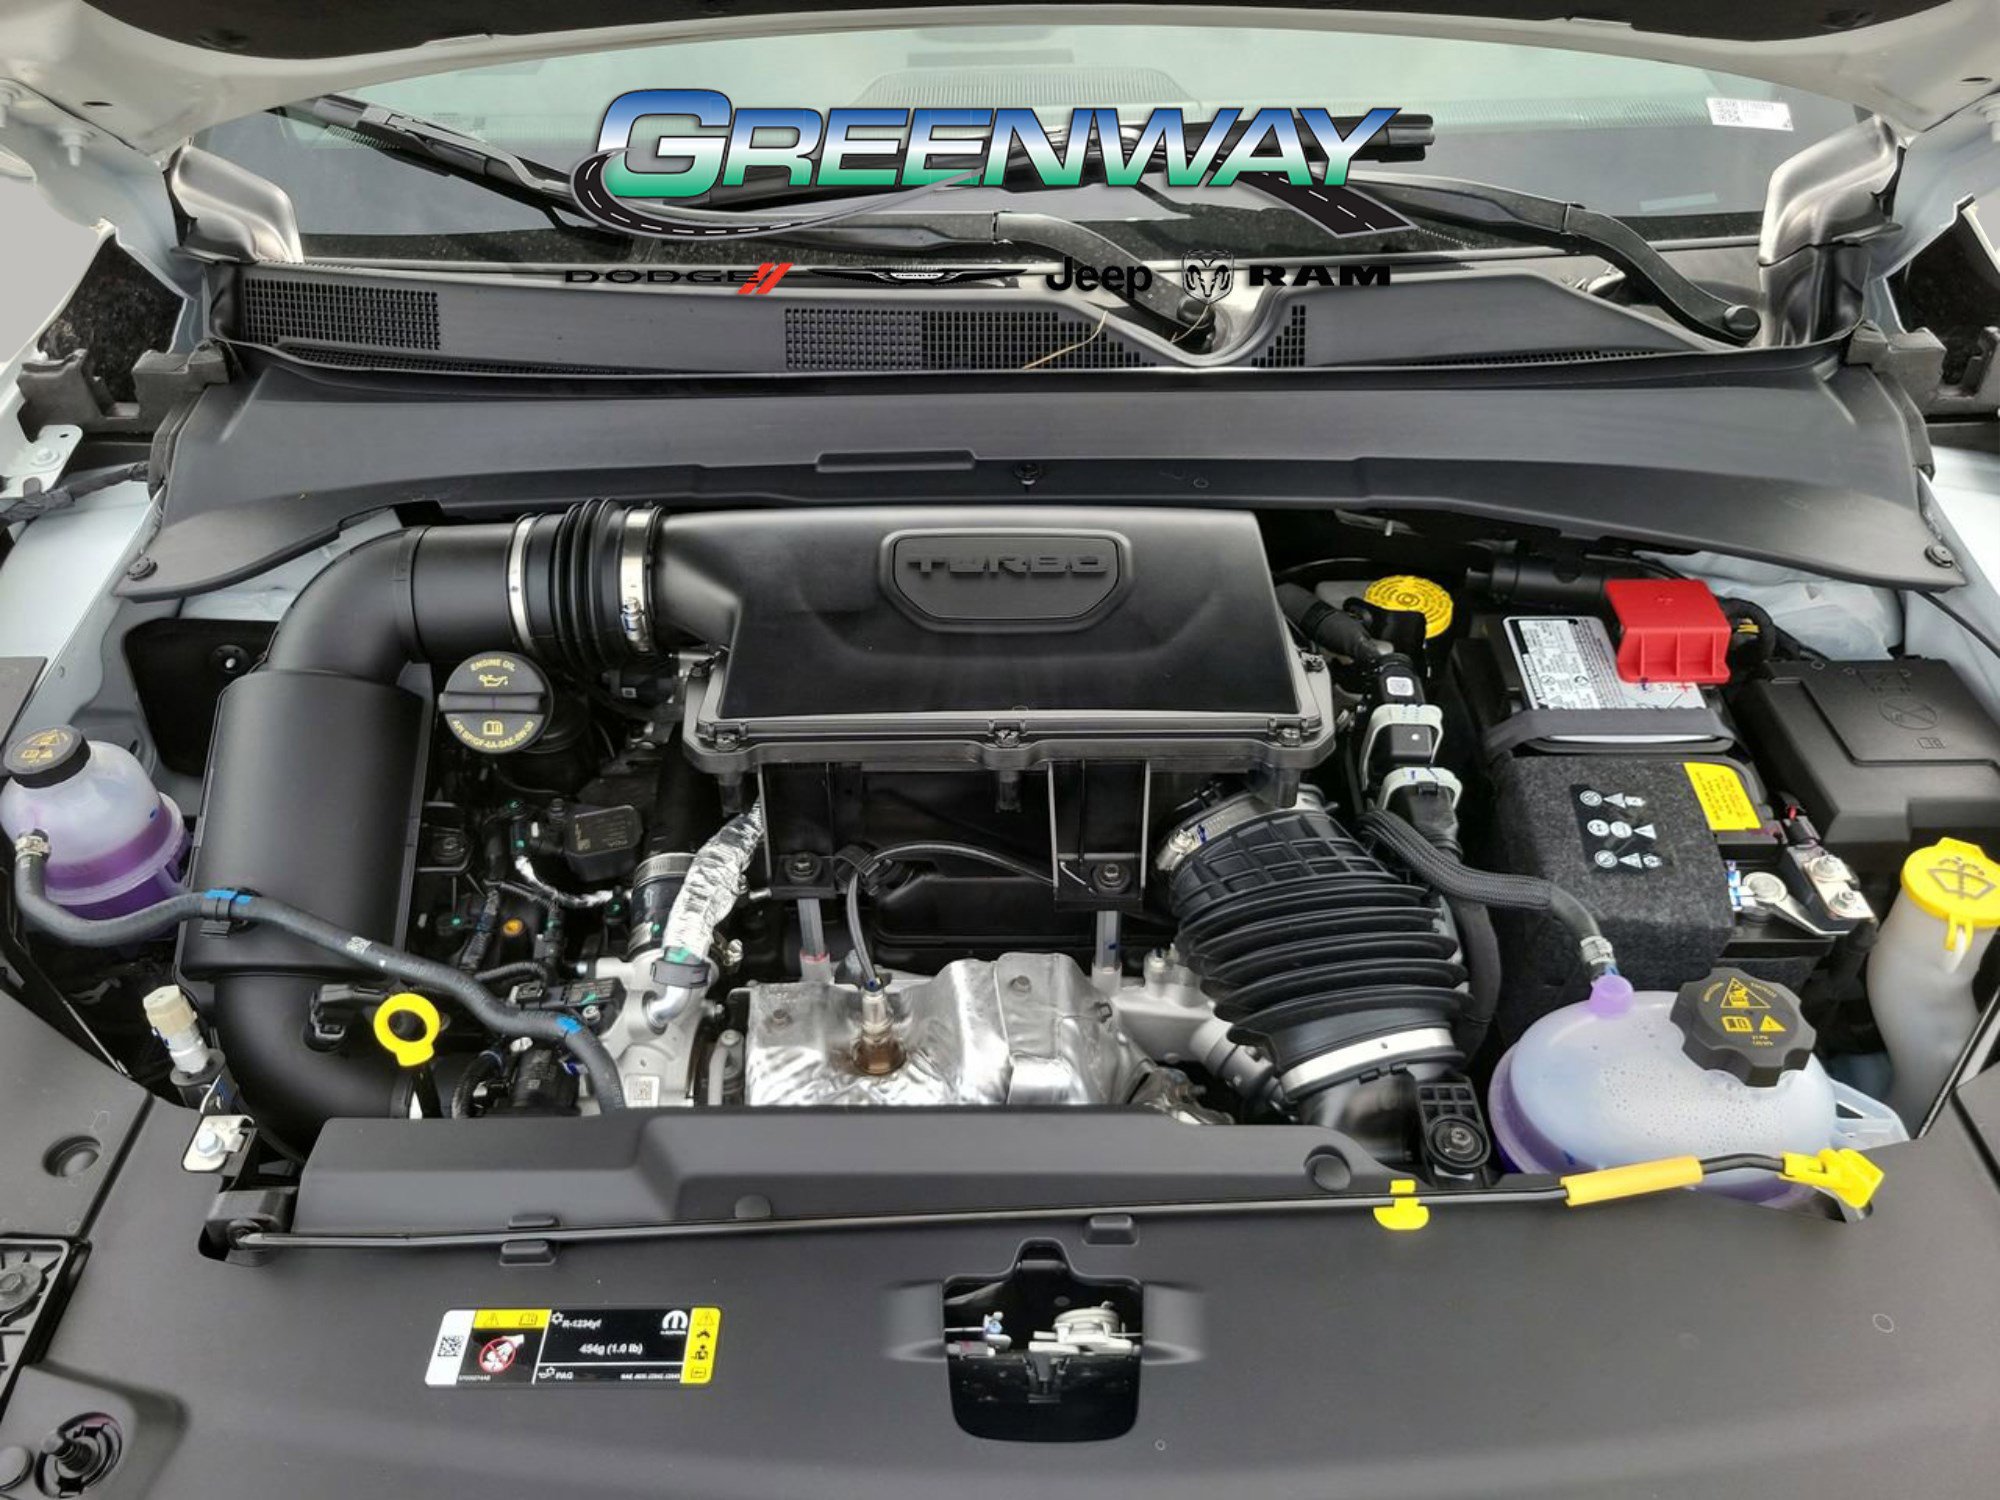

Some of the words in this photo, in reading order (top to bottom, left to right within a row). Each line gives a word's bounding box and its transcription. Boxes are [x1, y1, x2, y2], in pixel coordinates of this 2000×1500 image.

[907, 556, 1108, 578] TURBO
[470, 658, 502, 671] ENGINE
[503, 660, 516, 672] OIL
